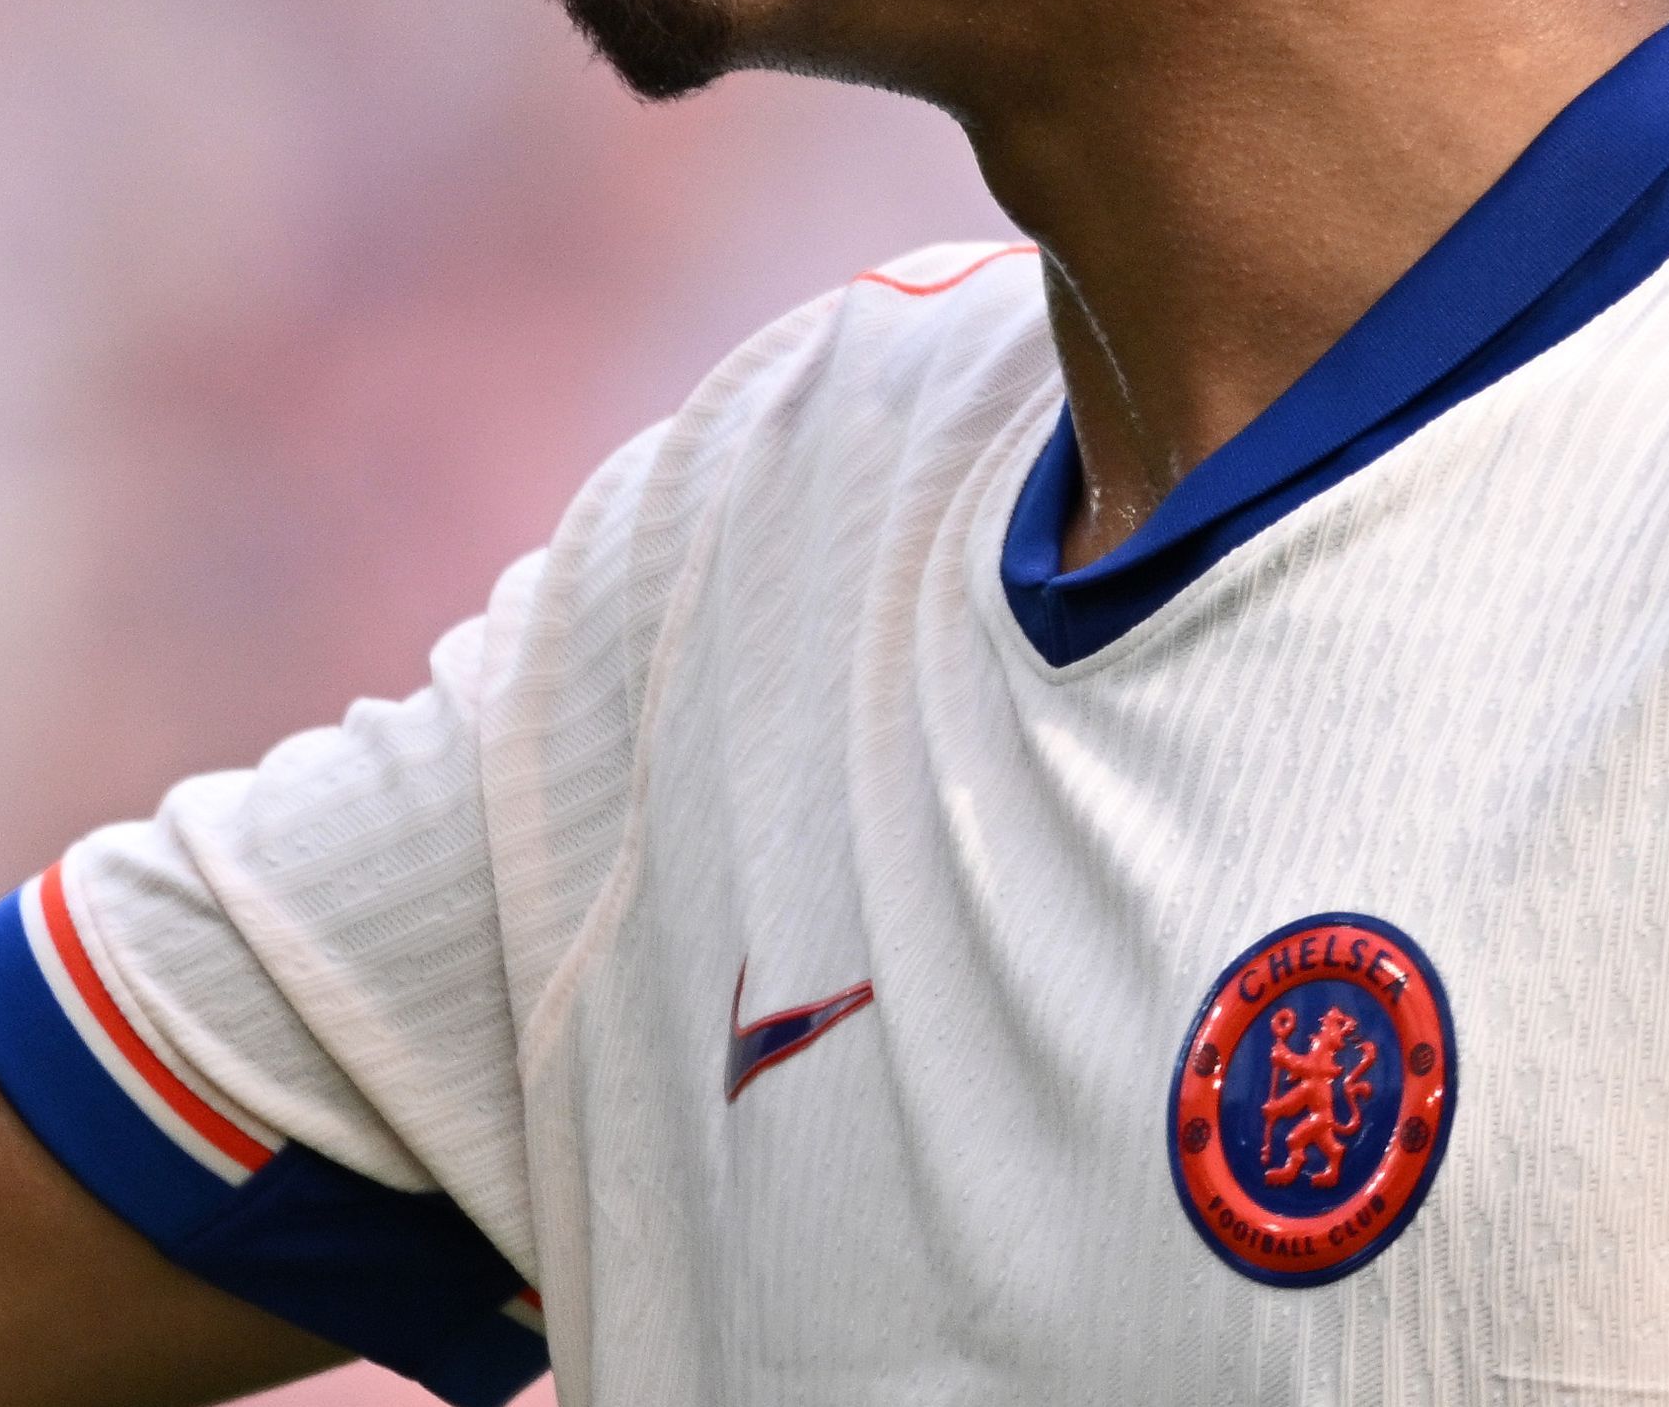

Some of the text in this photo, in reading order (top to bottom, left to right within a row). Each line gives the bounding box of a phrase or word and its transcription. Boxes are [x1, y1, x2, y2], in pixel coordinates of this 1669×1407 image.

[1239, 934, 1409, 1005] CHELSEA
[1208, 1195, 1386, 1256] FOOTBALL CLUB
